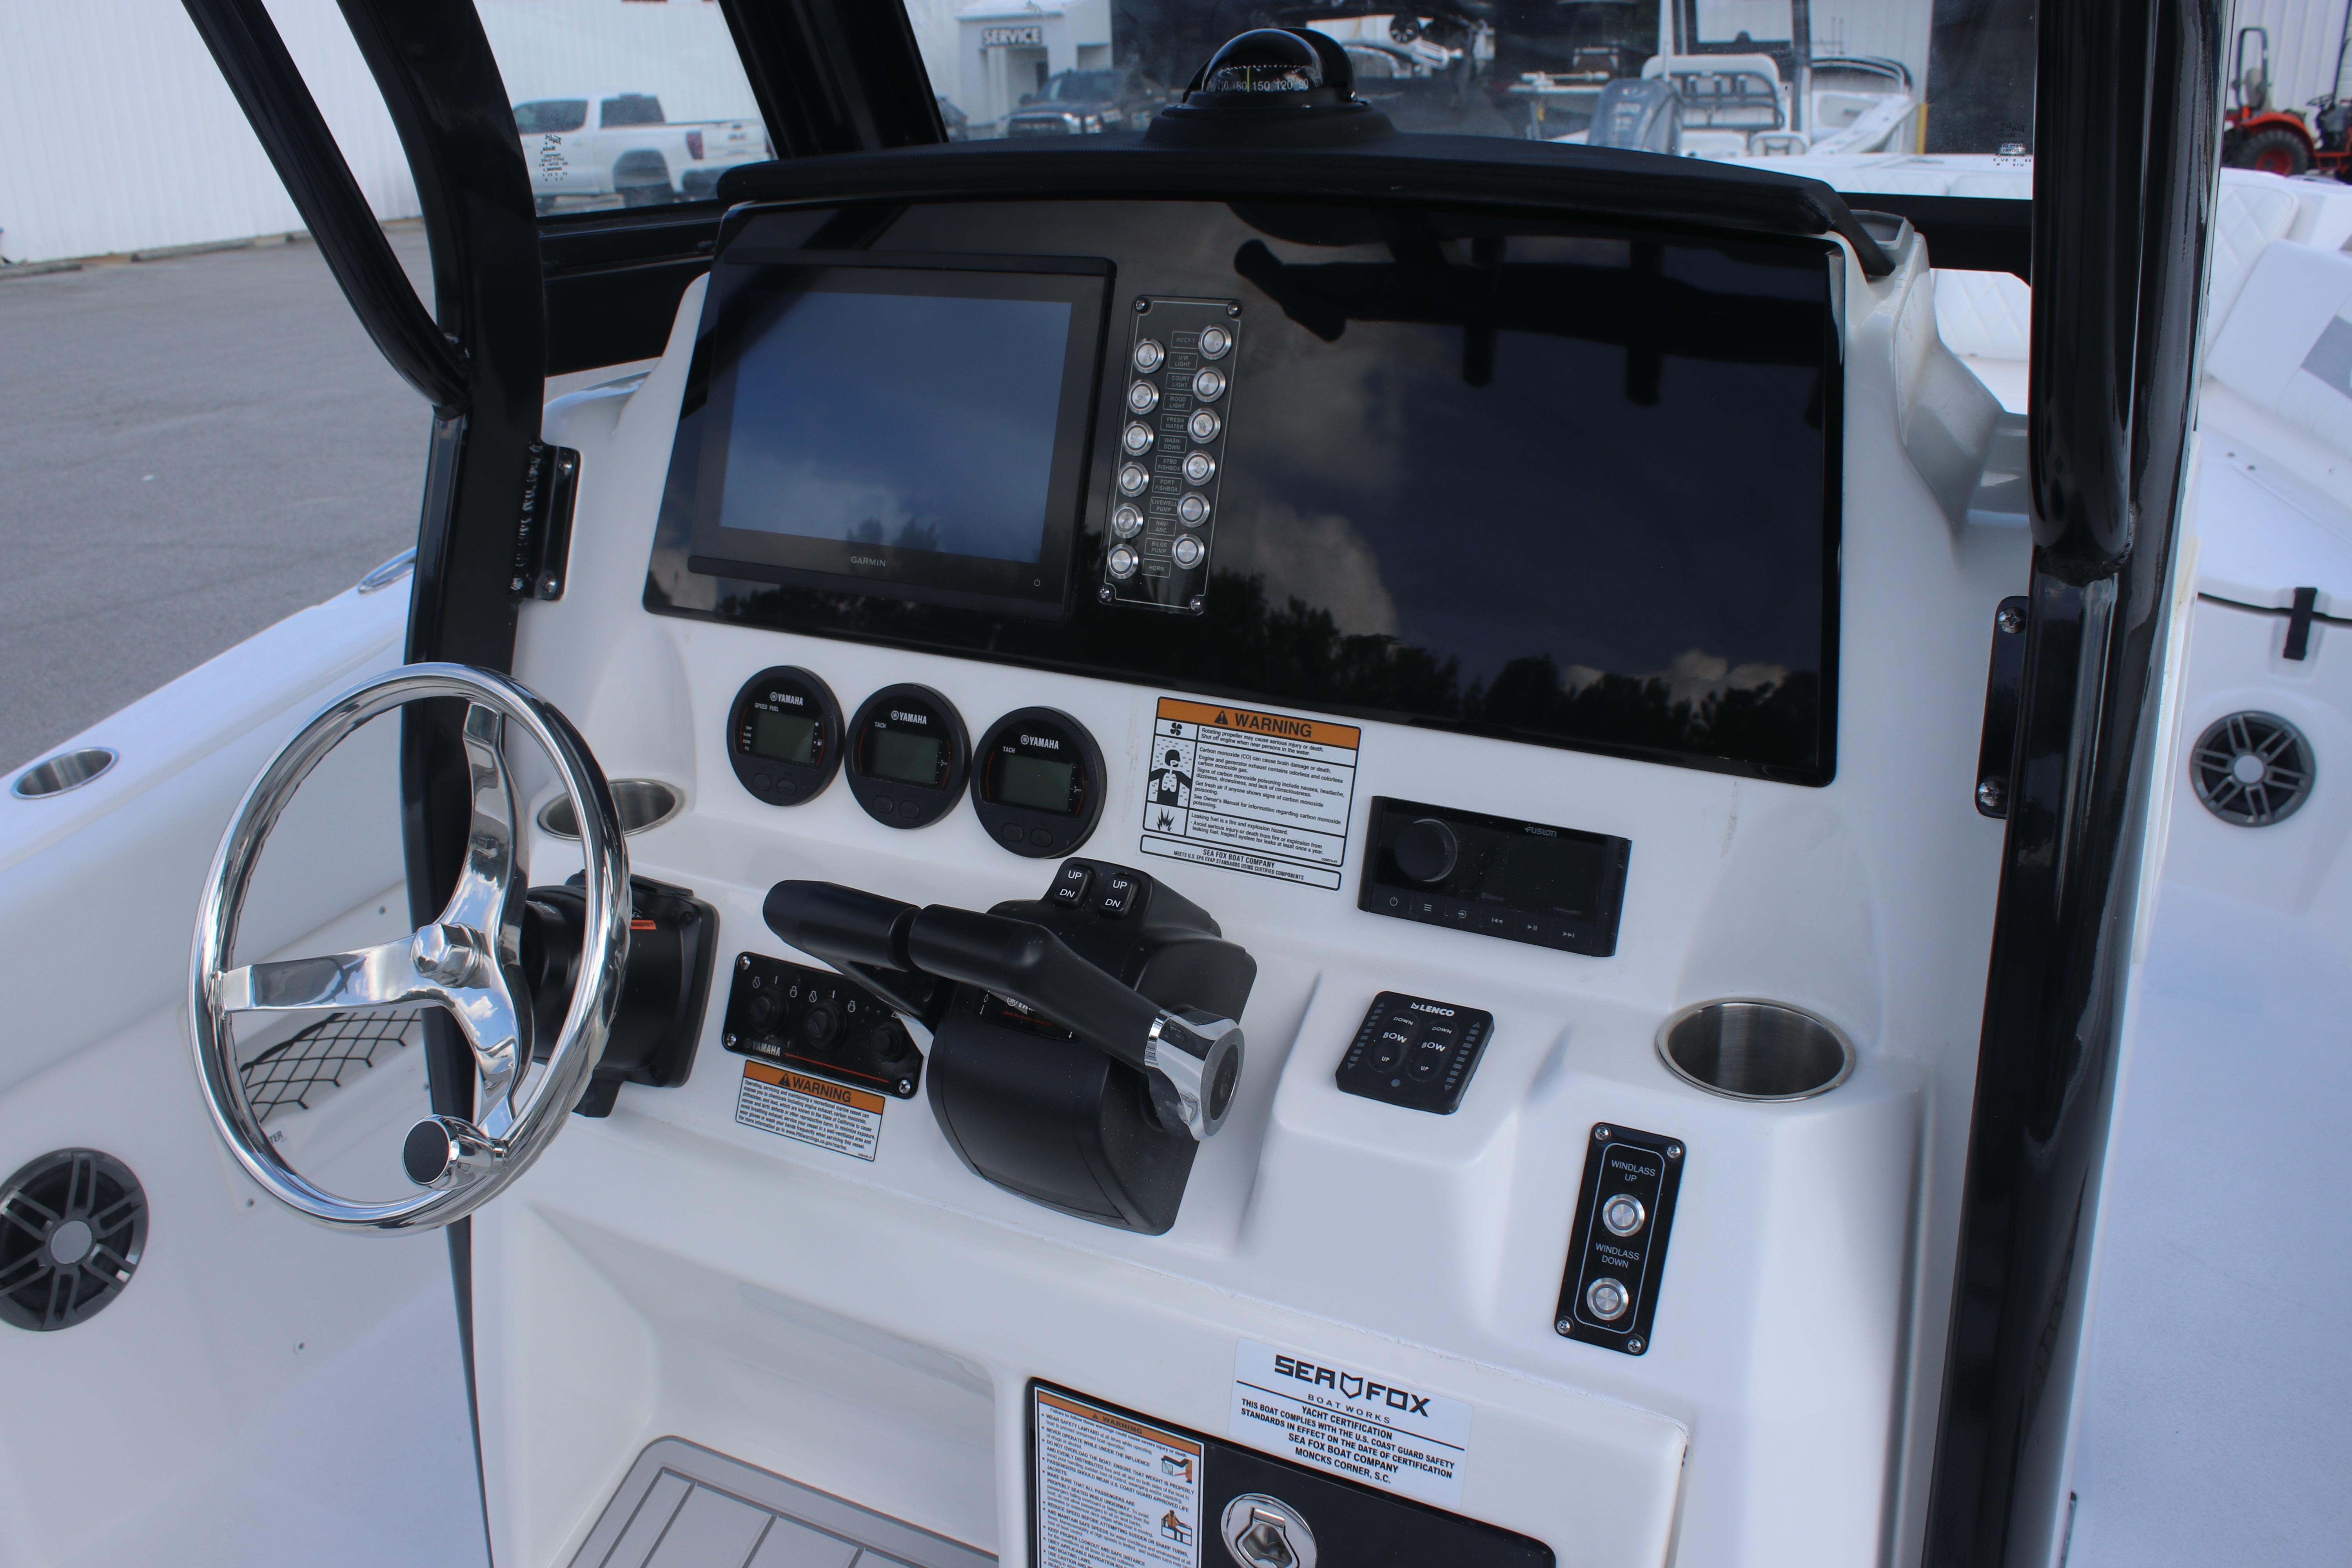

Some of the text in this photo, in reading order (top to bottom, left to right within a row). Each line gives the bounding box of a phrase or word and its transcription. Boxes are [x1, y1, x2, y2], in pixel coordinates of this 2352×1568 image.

[984, 28, 1040, 45] SERVICE
[1252, 81, 1270, 90] 150
[1276, 81, 1292, 90] 120
[1299, 80, 1308, 89] 90
[850, 555, 886, 567] GARMIN
[778, 693, 803, 706] YAMAHA
[899, 711, 927, 725] YAMAHA
[1201, 728, 1221, 737] Rotating
[1235, 713, 1312, 738] WARNING
[1029, 736, 1059, 750] YAMAHA
[1290, 762, 1309, 770] damage
[1525, 826, 1557, 837] FUSION
[1228, 854, 1244, 862] BOAT
[1245, 857, 1275, 868] COMPANY
[1068, 870, 1082, 880] UP
[1216, 858, 1240, 867] STANDARDS
[1254, 866, 1275, 874] CERTIFIED
[1275, 870, 1304, 880] COMPONENTS
[1112, 880, 1127, 889] UP
[1059, 889, 1075, 898] DN
[1105, 898, 1121, 908] DN
[1419, 1004, 1455, 1016] LENCO
[1394, 1016, 1414, 1025] DOWN
[1383, 1032, 1407, 1044] BOW
[752, 1041, 780, 1056] YAMAHA
[1421, 1042, 1446, 1052] BOW
[793, 1076, 851, 1103] WARNING
[1611, 1160, 1655, 1176] WINDLASS
[1595, 1243, 1639, 1261] WINDLASS
[1602, 1255, 1629, 1268] DOWN
[1274, 1354, 1430, 1417] SEA FOX
[1308, 1394, 1390, 1424] BOAT WORKS
[1103, 1416, 1142, 1434] WARNING
[1302, 1406, 1392, 1440] YACHT CERTIFICATION
[1242, 1398, 1454, 1469] THIS BOAT COMPLIES WITH THE U.S. COAST GUARD SAFETY
[1241, 1408, 1452, 1479] STANDARDS IN EFFECT ON THE DATE OF CERTIFICATION
[1289, 1432, 1398, 1473] SEA FOX BOAT COMPANY
[1295, 1447, 1390, 1484] MONCKS CORNER, S.C.
